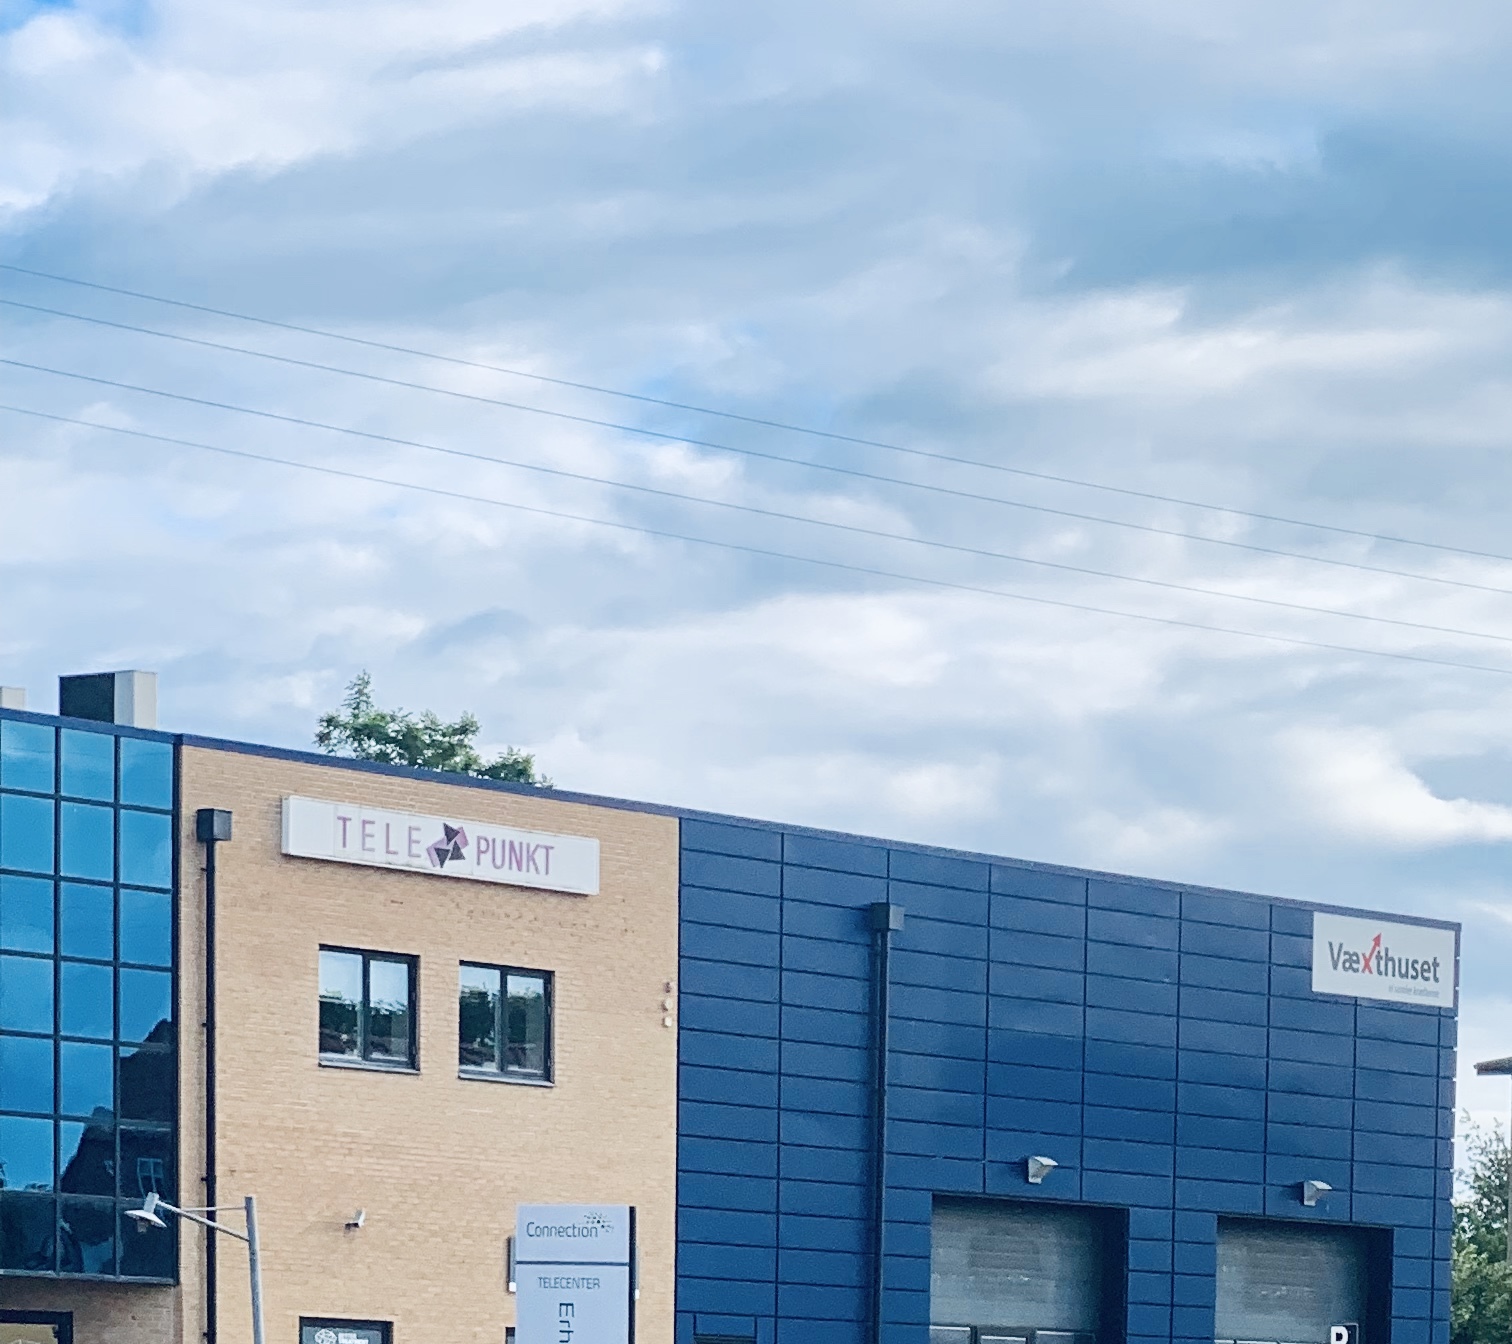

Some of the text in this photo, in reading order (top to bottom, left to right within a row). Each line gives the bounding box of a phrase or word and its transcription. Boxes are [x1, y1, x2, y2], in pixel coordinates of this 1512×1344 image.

[336, 816, 554, 876] TELE PUNKT
[1328, 933, 1440, 983] Væxthuset
[526, 1221, 598, 1238] Connection
[538, 1276, 600, 1290] TELECENTER
